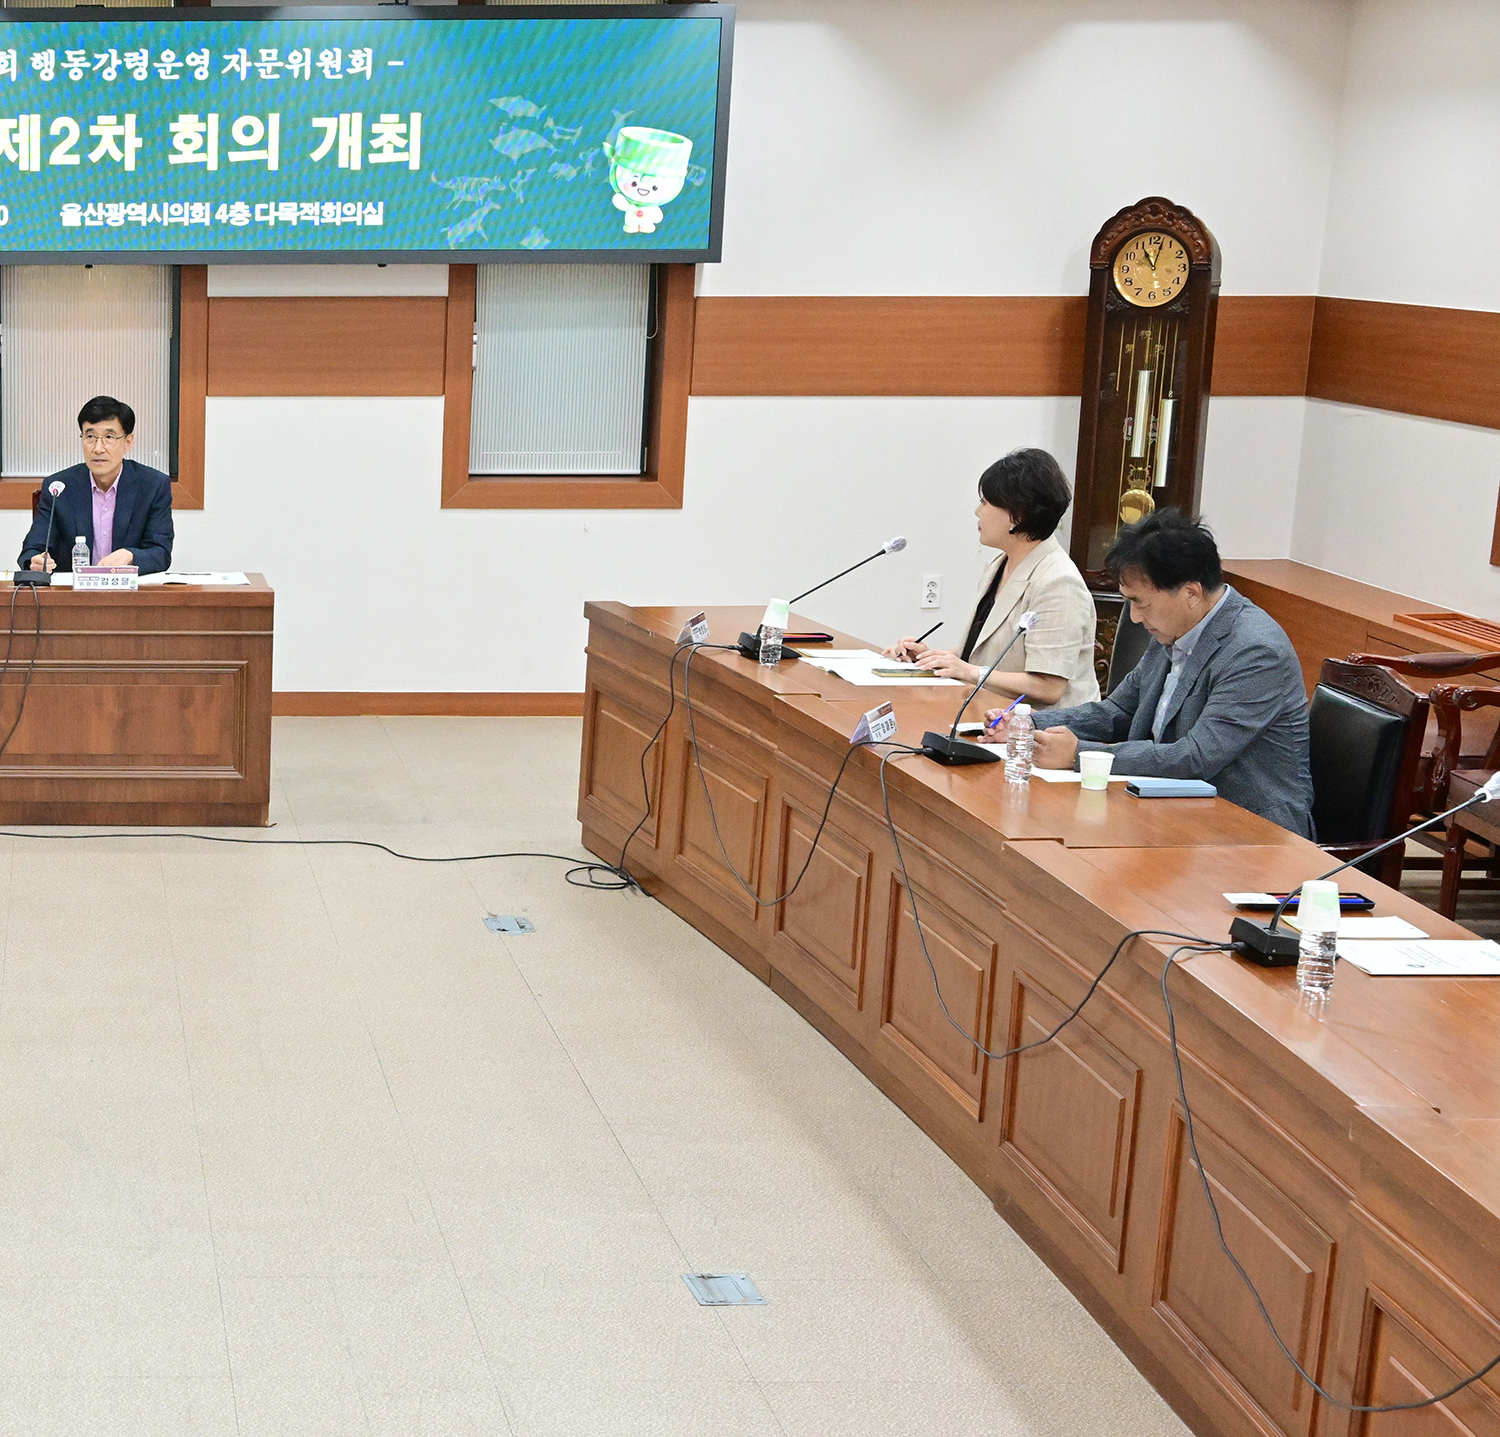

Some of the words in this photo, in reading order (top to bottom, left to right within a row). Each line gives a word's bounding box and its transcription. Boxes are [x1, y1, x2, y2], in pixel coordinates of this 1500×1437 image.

[29, 48, 210, 82] 행동강령운영
[221, 47, 373, 81] 자문위원회
[168, 112, 280, 171] 회의
[309, 112, 422, 171] 개최
[59, 201, 211, 227] 울산광역시의회
[214, 201, 252, 227] 4층
[254, 201, 384, 226] 다목적회의실
[1149, 236, 1161, 245] 12
[1169, 240, 1173, 248] 1
[1135, 241, 1145, 250] 11
[1125, 252, 1136, 261] 10
[1175, 250, 1183, 259] 2
[1121, 265, 1130, 274] 9
[1178, 263, 1187, 272] 3
[1124, 277, 1133, 286] 8
[1172, 276, 1180, 285] 4
[1134, 287, 1143, 296] 7
[1148, 291, 1156, 300] 6
[1162, 287, 1172, 296] 5
